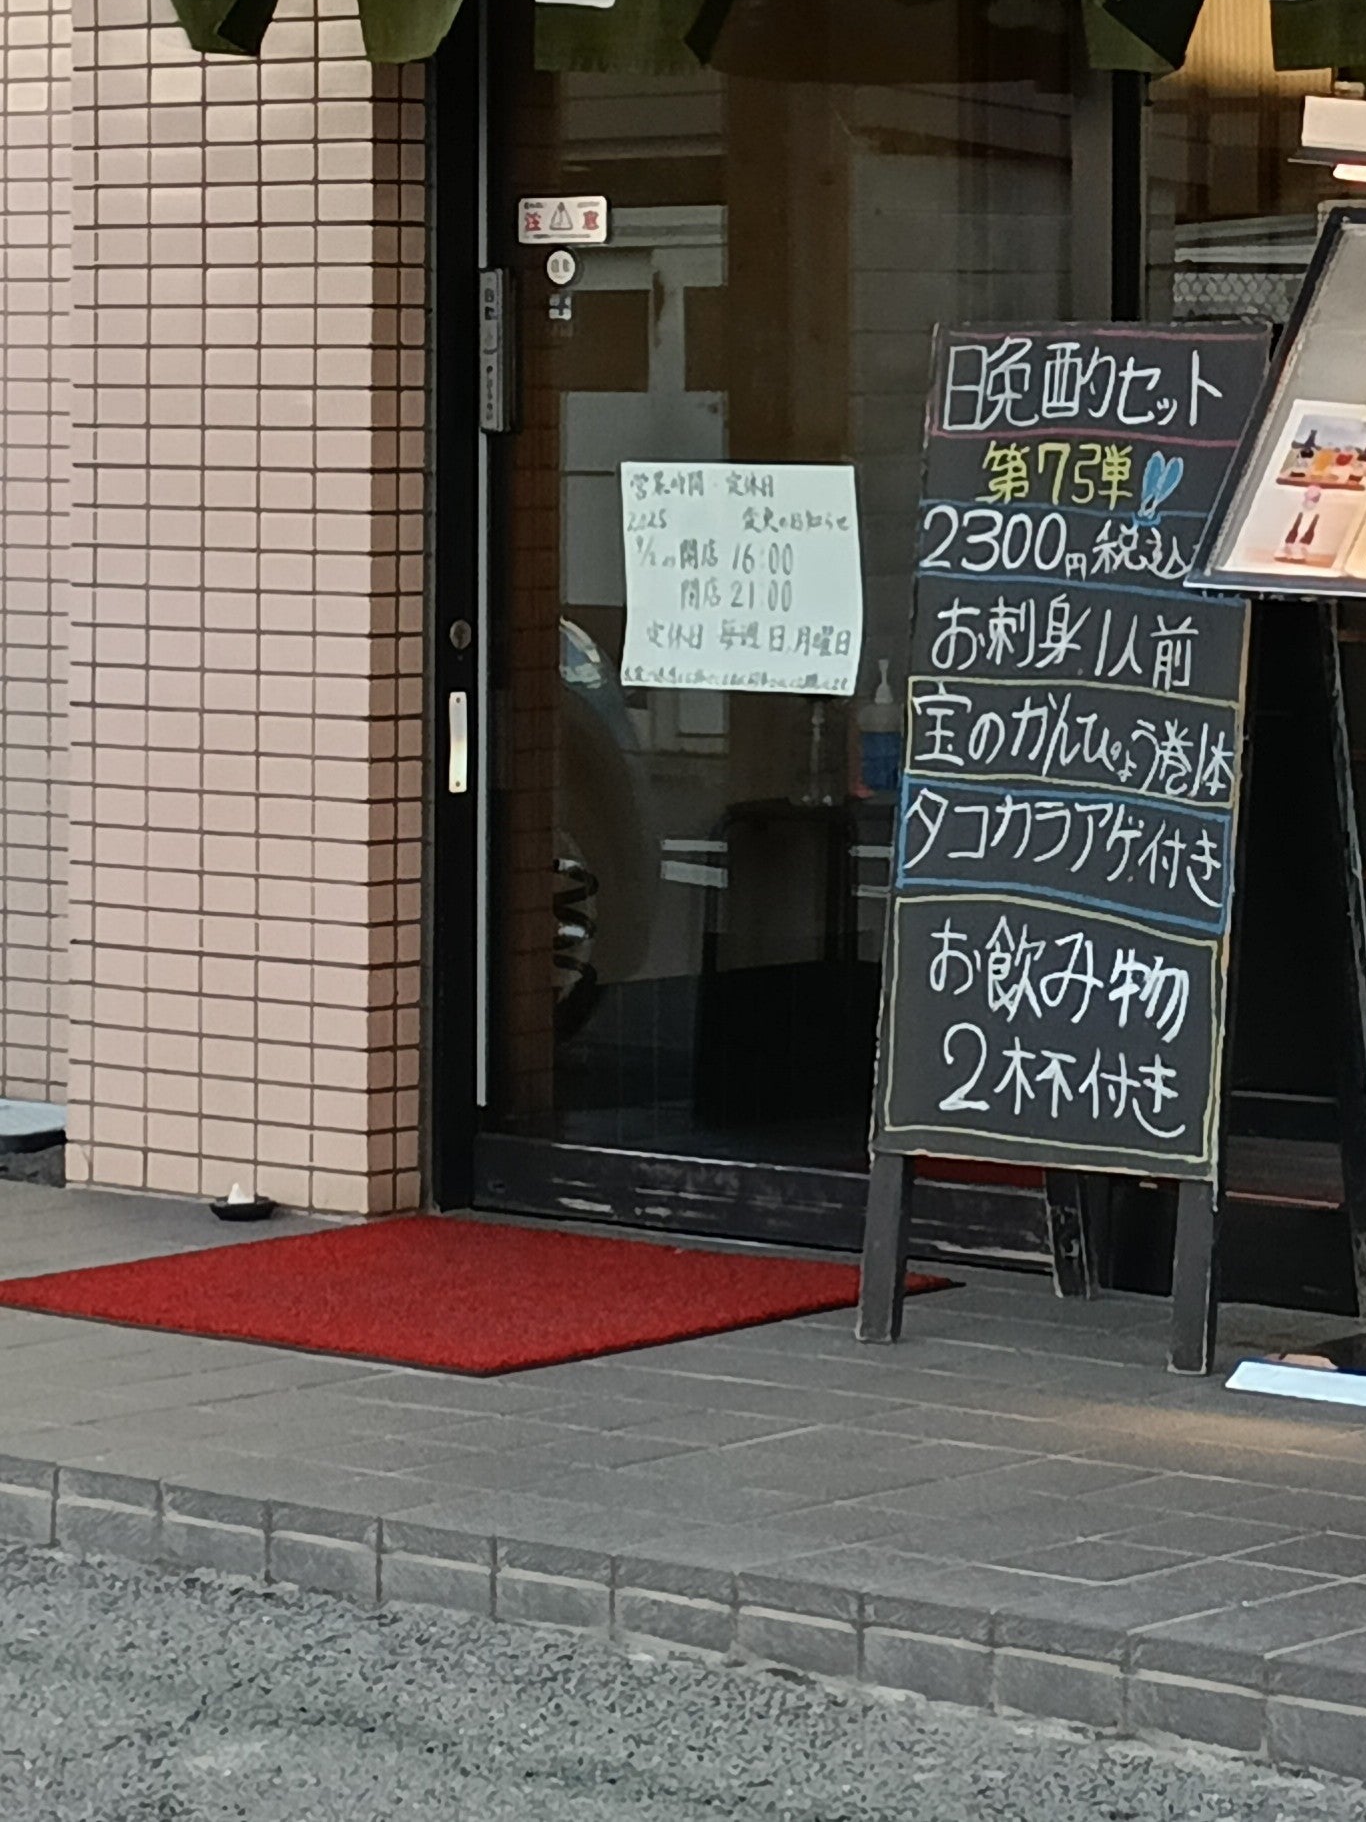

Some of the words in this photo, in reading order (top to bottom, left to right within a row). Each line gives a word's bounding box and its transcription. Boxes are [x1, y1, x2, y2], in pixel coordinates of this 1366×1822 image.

[943, 336, 1223, 431] 晩酌セット
[931, 593, 1199, 690] お刺身1人前
[902, 787, 1223, 907] タコカラアゲ付き
[929, 915, 1190, 1043] お飲み物
[938, 1023, 1186, 1138] 2杯付き
